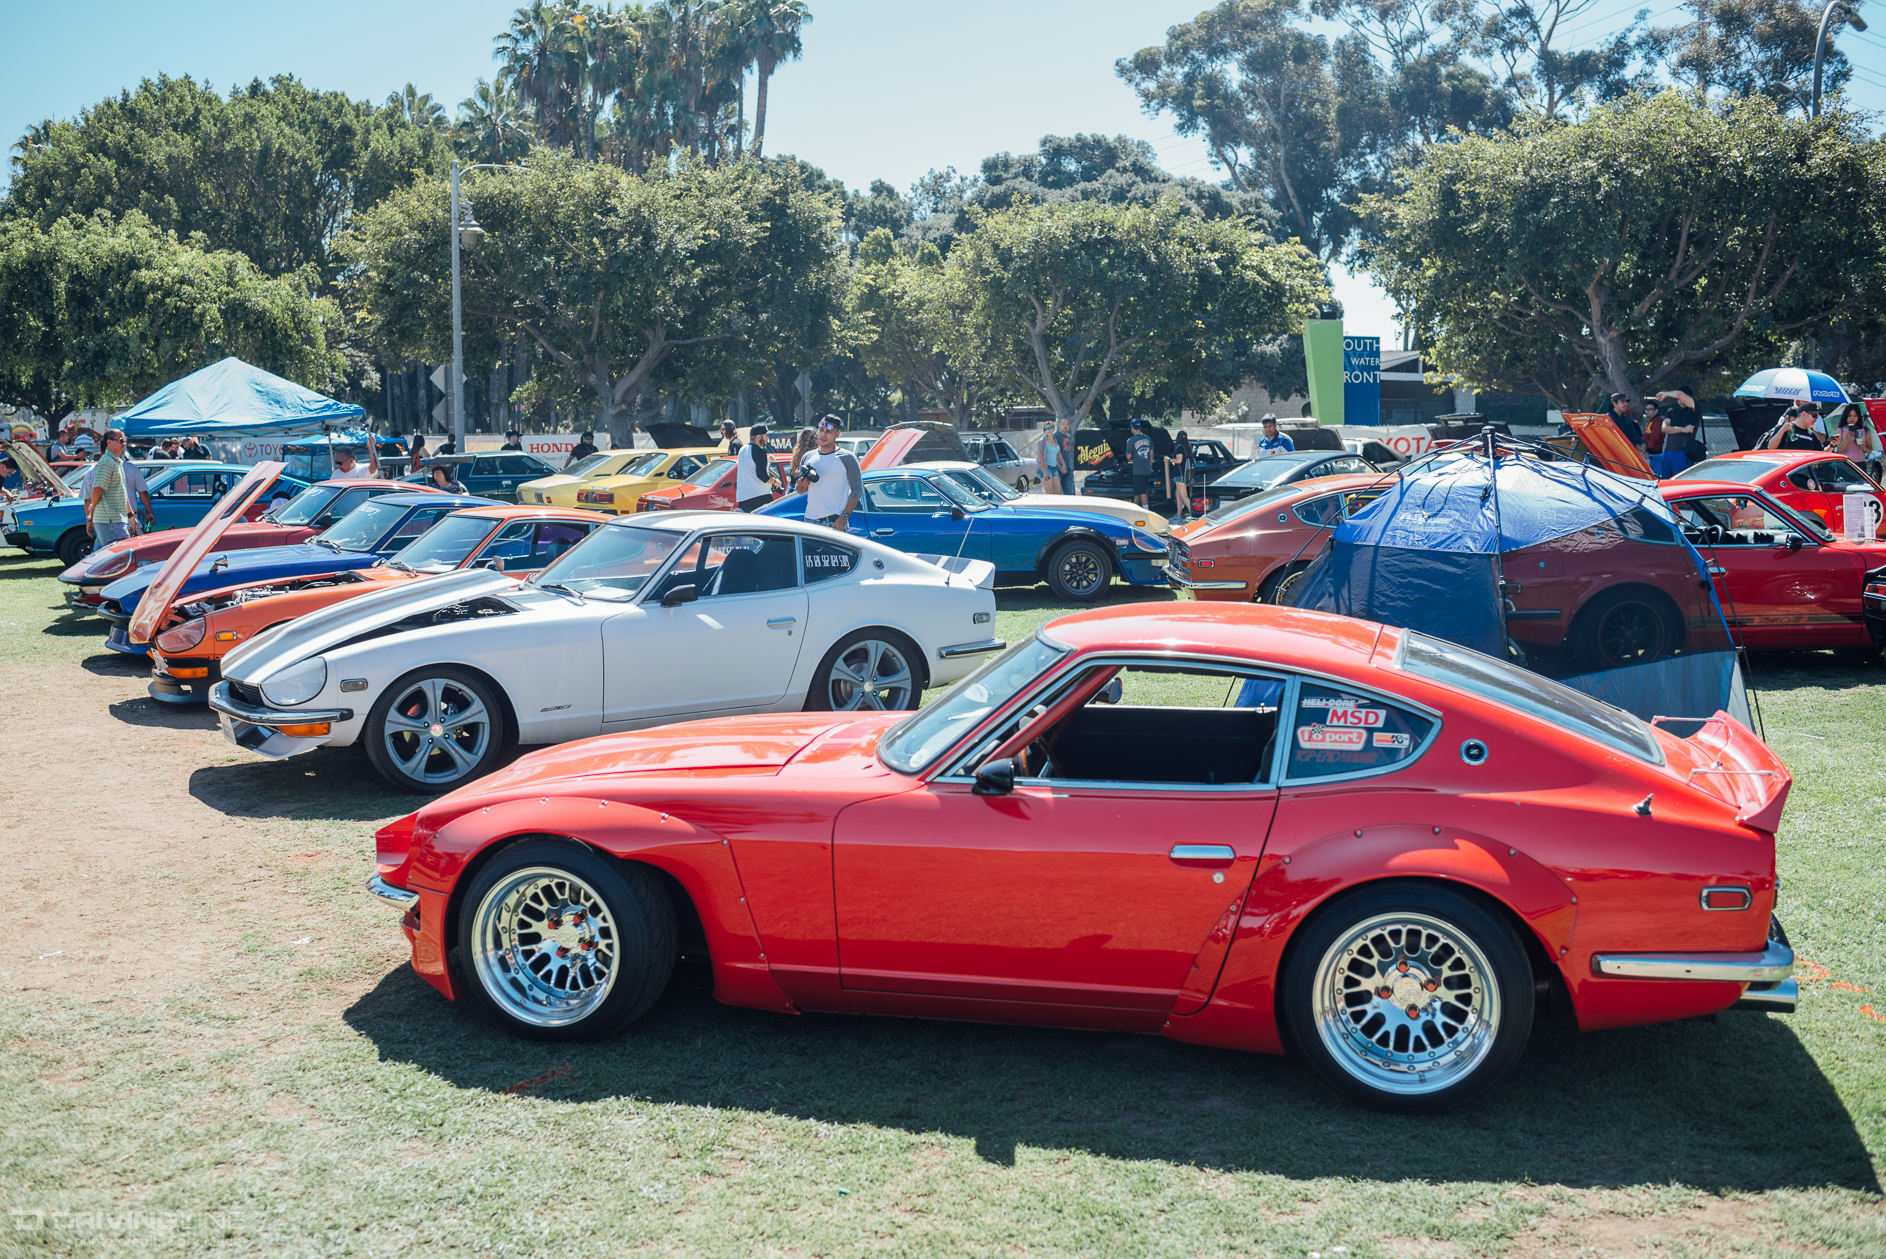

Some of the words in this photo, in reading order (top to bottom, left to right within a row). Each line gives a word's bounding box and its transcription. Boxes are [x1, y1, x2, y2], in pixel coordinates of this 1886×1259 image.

[1351, 357, 1381, 366] WATER
[529, 442, 582, 454] HOND
[767, 438, 793, 449] AMA
[1377, 436, 1438, 455] YOTA
[1757, 616, 1804, 624] 240Z
[1329, 709, 1380, 726] MSD
[1325, 732, 1360, 743] port
